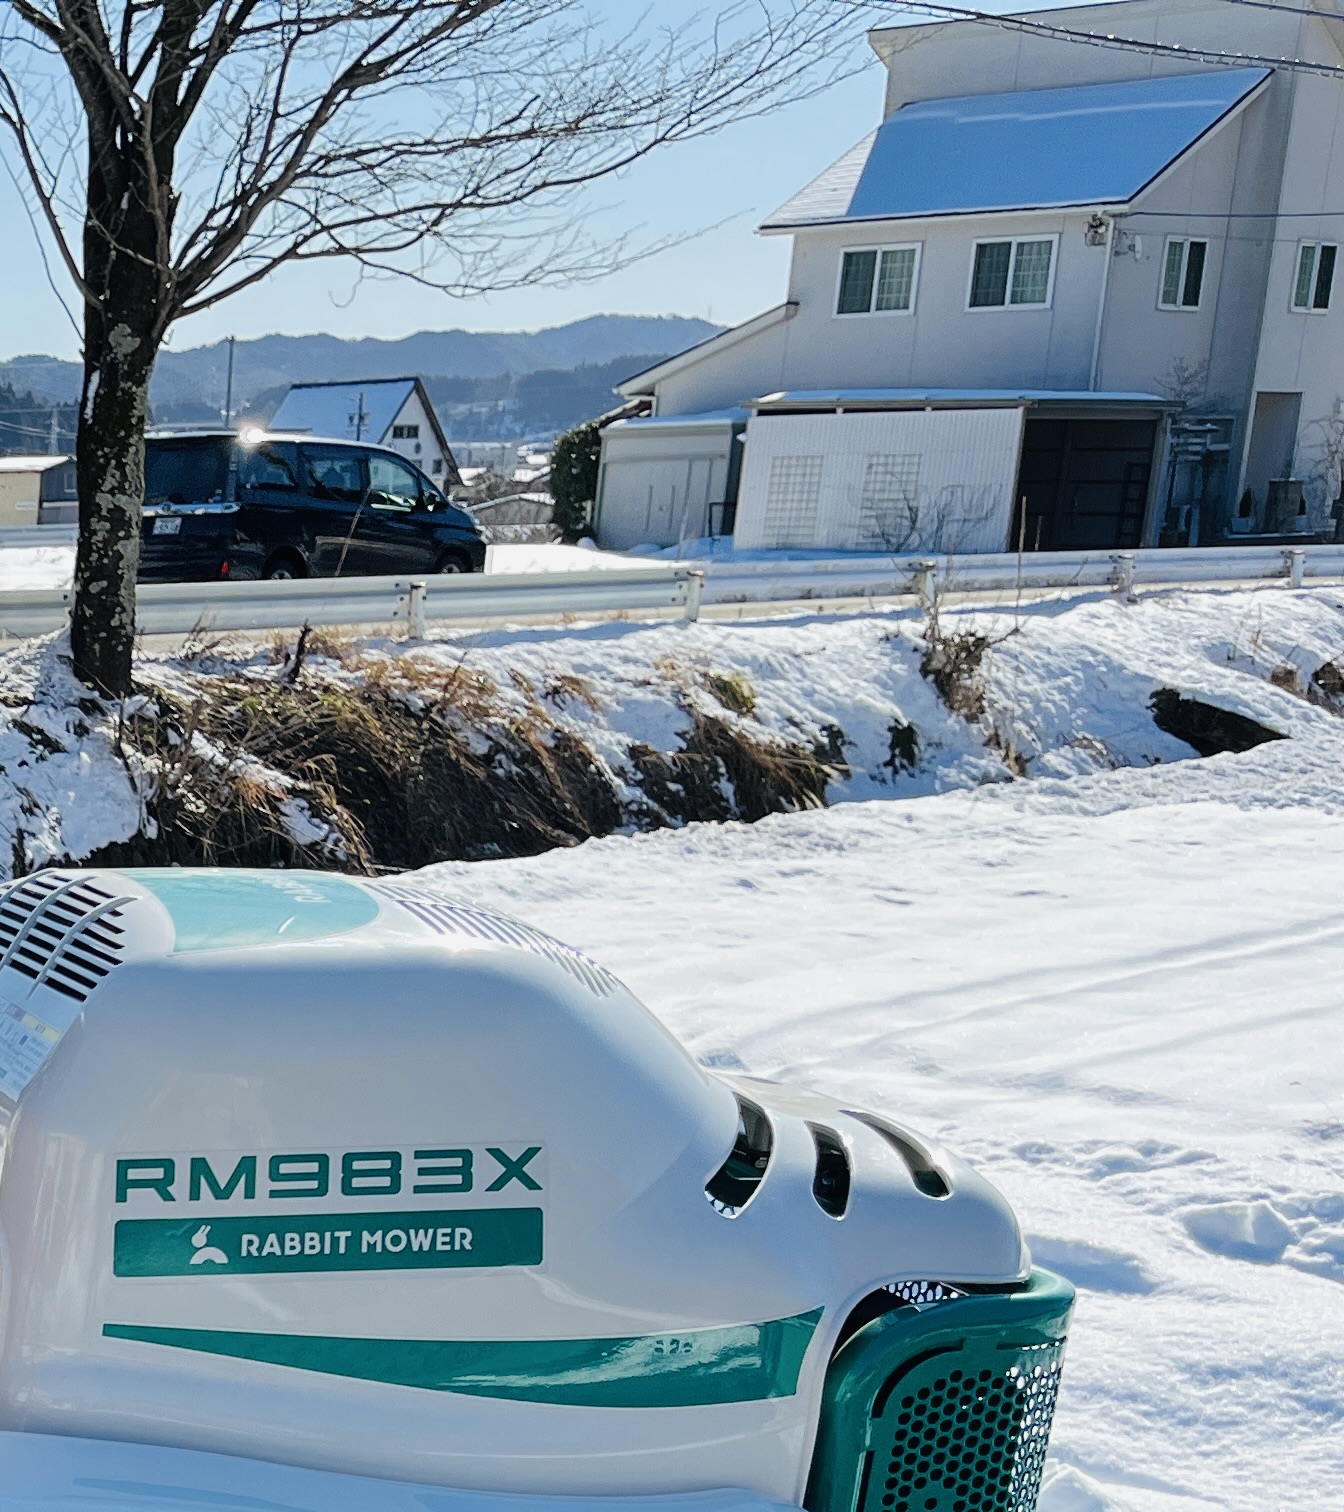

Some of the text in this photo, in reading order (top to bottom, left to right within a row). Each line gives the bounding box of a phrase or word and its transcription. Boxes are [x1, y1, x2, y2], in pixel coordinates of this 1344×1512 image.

[115, 1146, 544, 1204] RM983X
[240, 1227, 474, 1258] RABBIT MOWER
